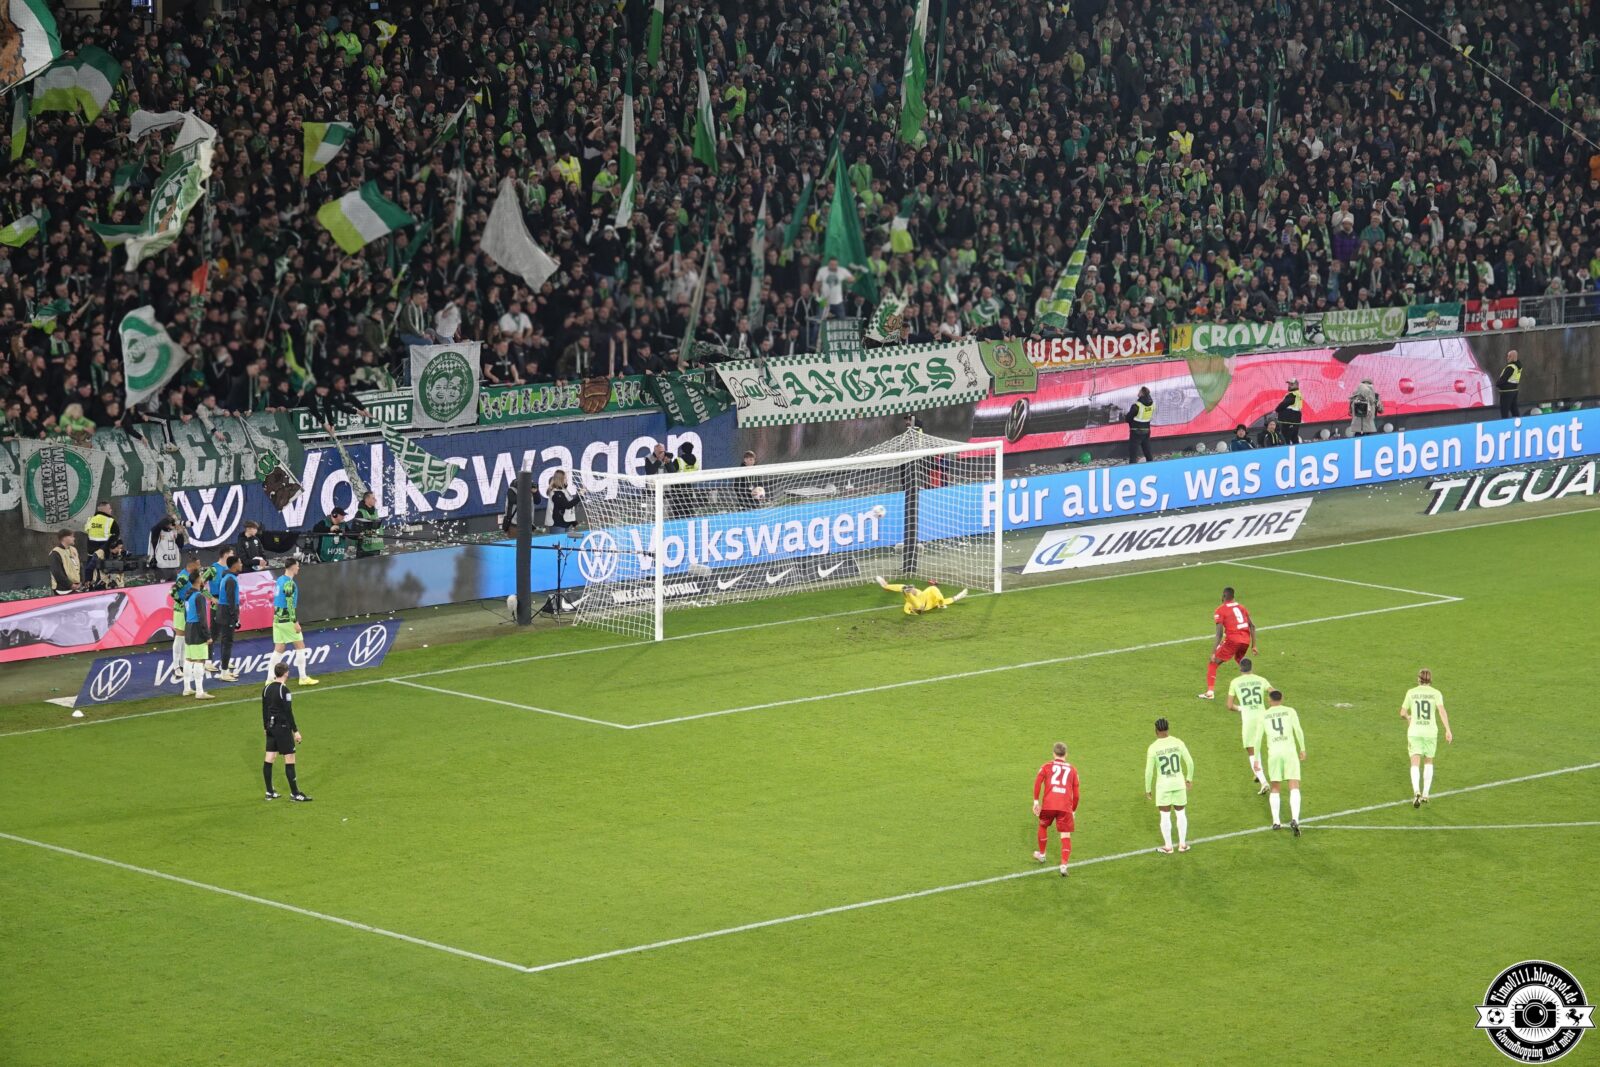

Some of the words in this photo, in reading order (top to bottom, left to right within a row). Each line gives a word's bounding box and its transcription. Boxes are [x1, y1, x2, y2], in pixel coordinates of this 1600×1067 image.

[1026, 328, 1161, 364] WESENDORF
[783, 357, 956, 406] ANGELS
[52, 446, 70, 521] WEEKEND
[981, 477, 1049, 527] Für
[1062, 467, 1169, 518] alles,
[1184, 462, 1261, 501] was
[1275, 445, 1340, 490] das
[1353, 429, 1462, 480] Leben
[1475, 416, 1583, 464] bringt
[1423, 460, 1600, 516] TIGUA
[630, 509, 879, 571] Volkswagen
[1092, 518, 1235, 557] LINGLONG
[1232, 508, 1304, 540] TIRE
[1232, 606, 1245, 624] 9
[1240, 686, 1262, 706] 25
[1415, 700, 1431, 720] 19
[1271, 717, 1284, 736] 4
[1050, 764, 1071, 786] 27
[1158, 753, 1180, 775] 20
